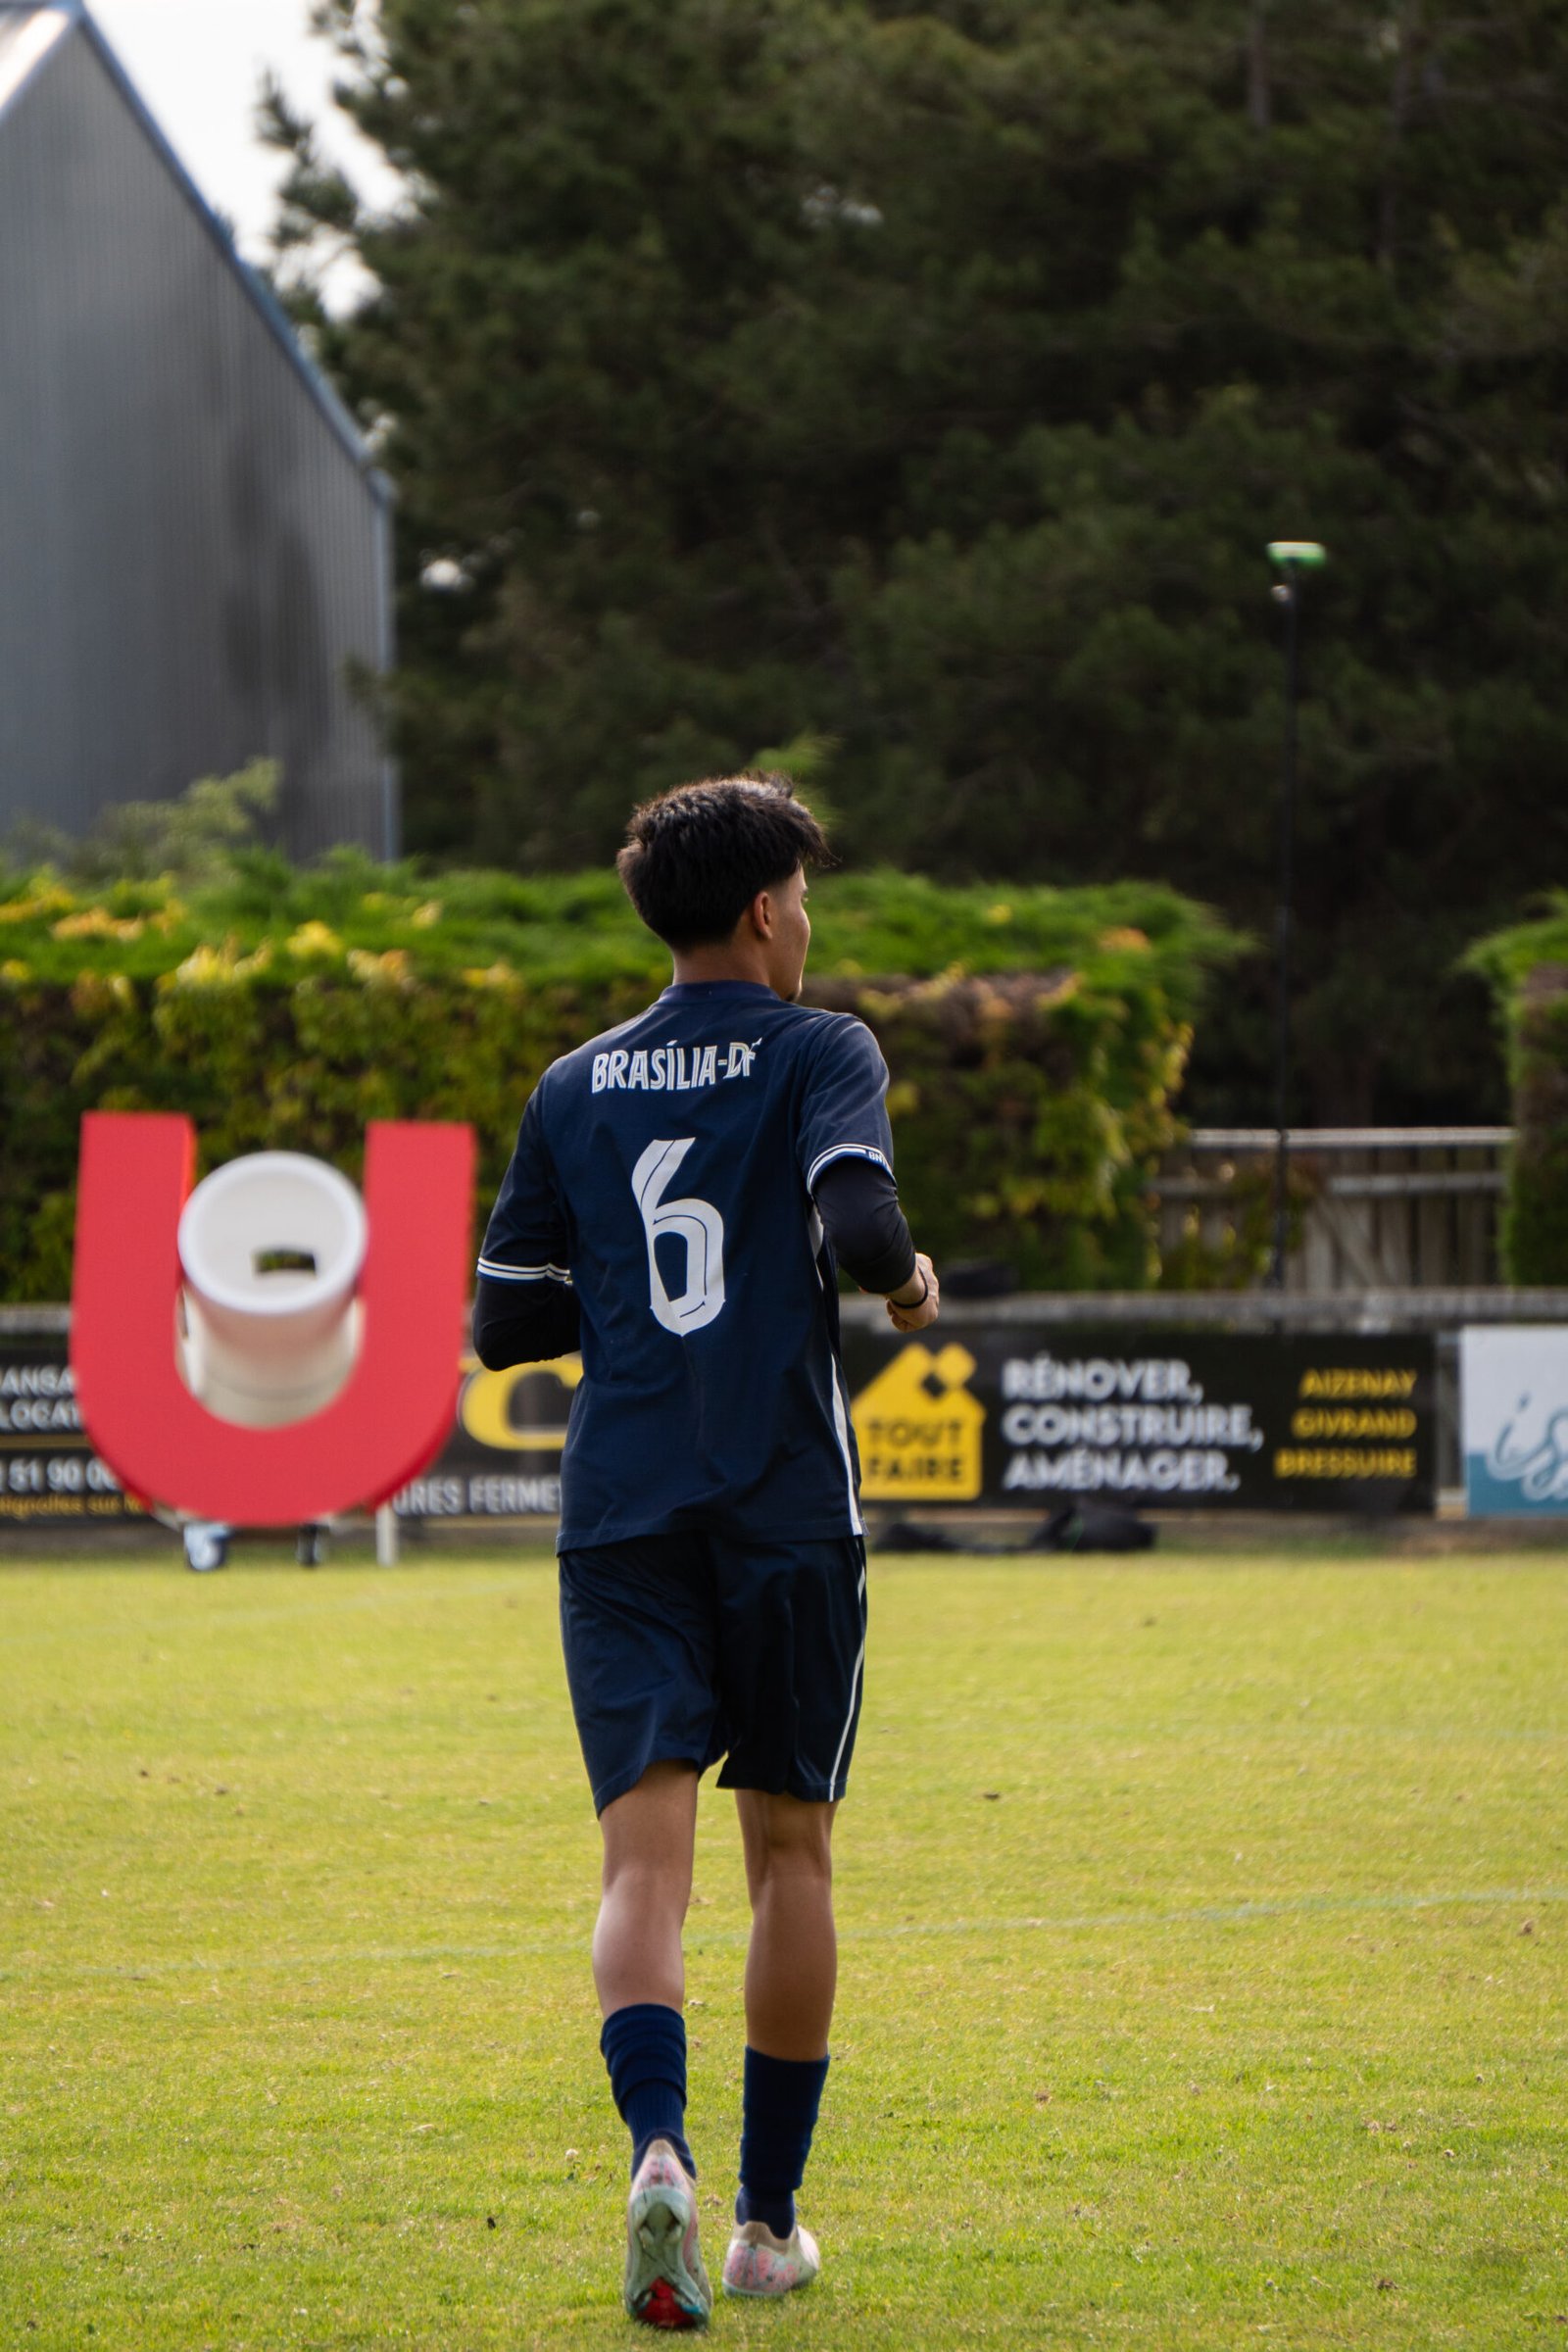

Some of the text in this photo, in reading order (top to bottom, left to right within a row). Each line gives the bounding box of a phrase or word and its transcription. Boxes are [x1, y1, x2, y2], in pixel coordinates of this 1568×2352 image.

[631, 1137, 726, 1338] 6
[1003, 1350, 1204, 1403] RÉNOVER,
[867, 1419, 961, 1447] TOUT
[1003, 1403, 1264, 1451] CONSTRUIRE,
[867, 1455, 962, 1483] FAIRE
[1004, 1446, 1241, 1493] AMÉNAGER.
[468, 1474, 561, 1514] FERME
